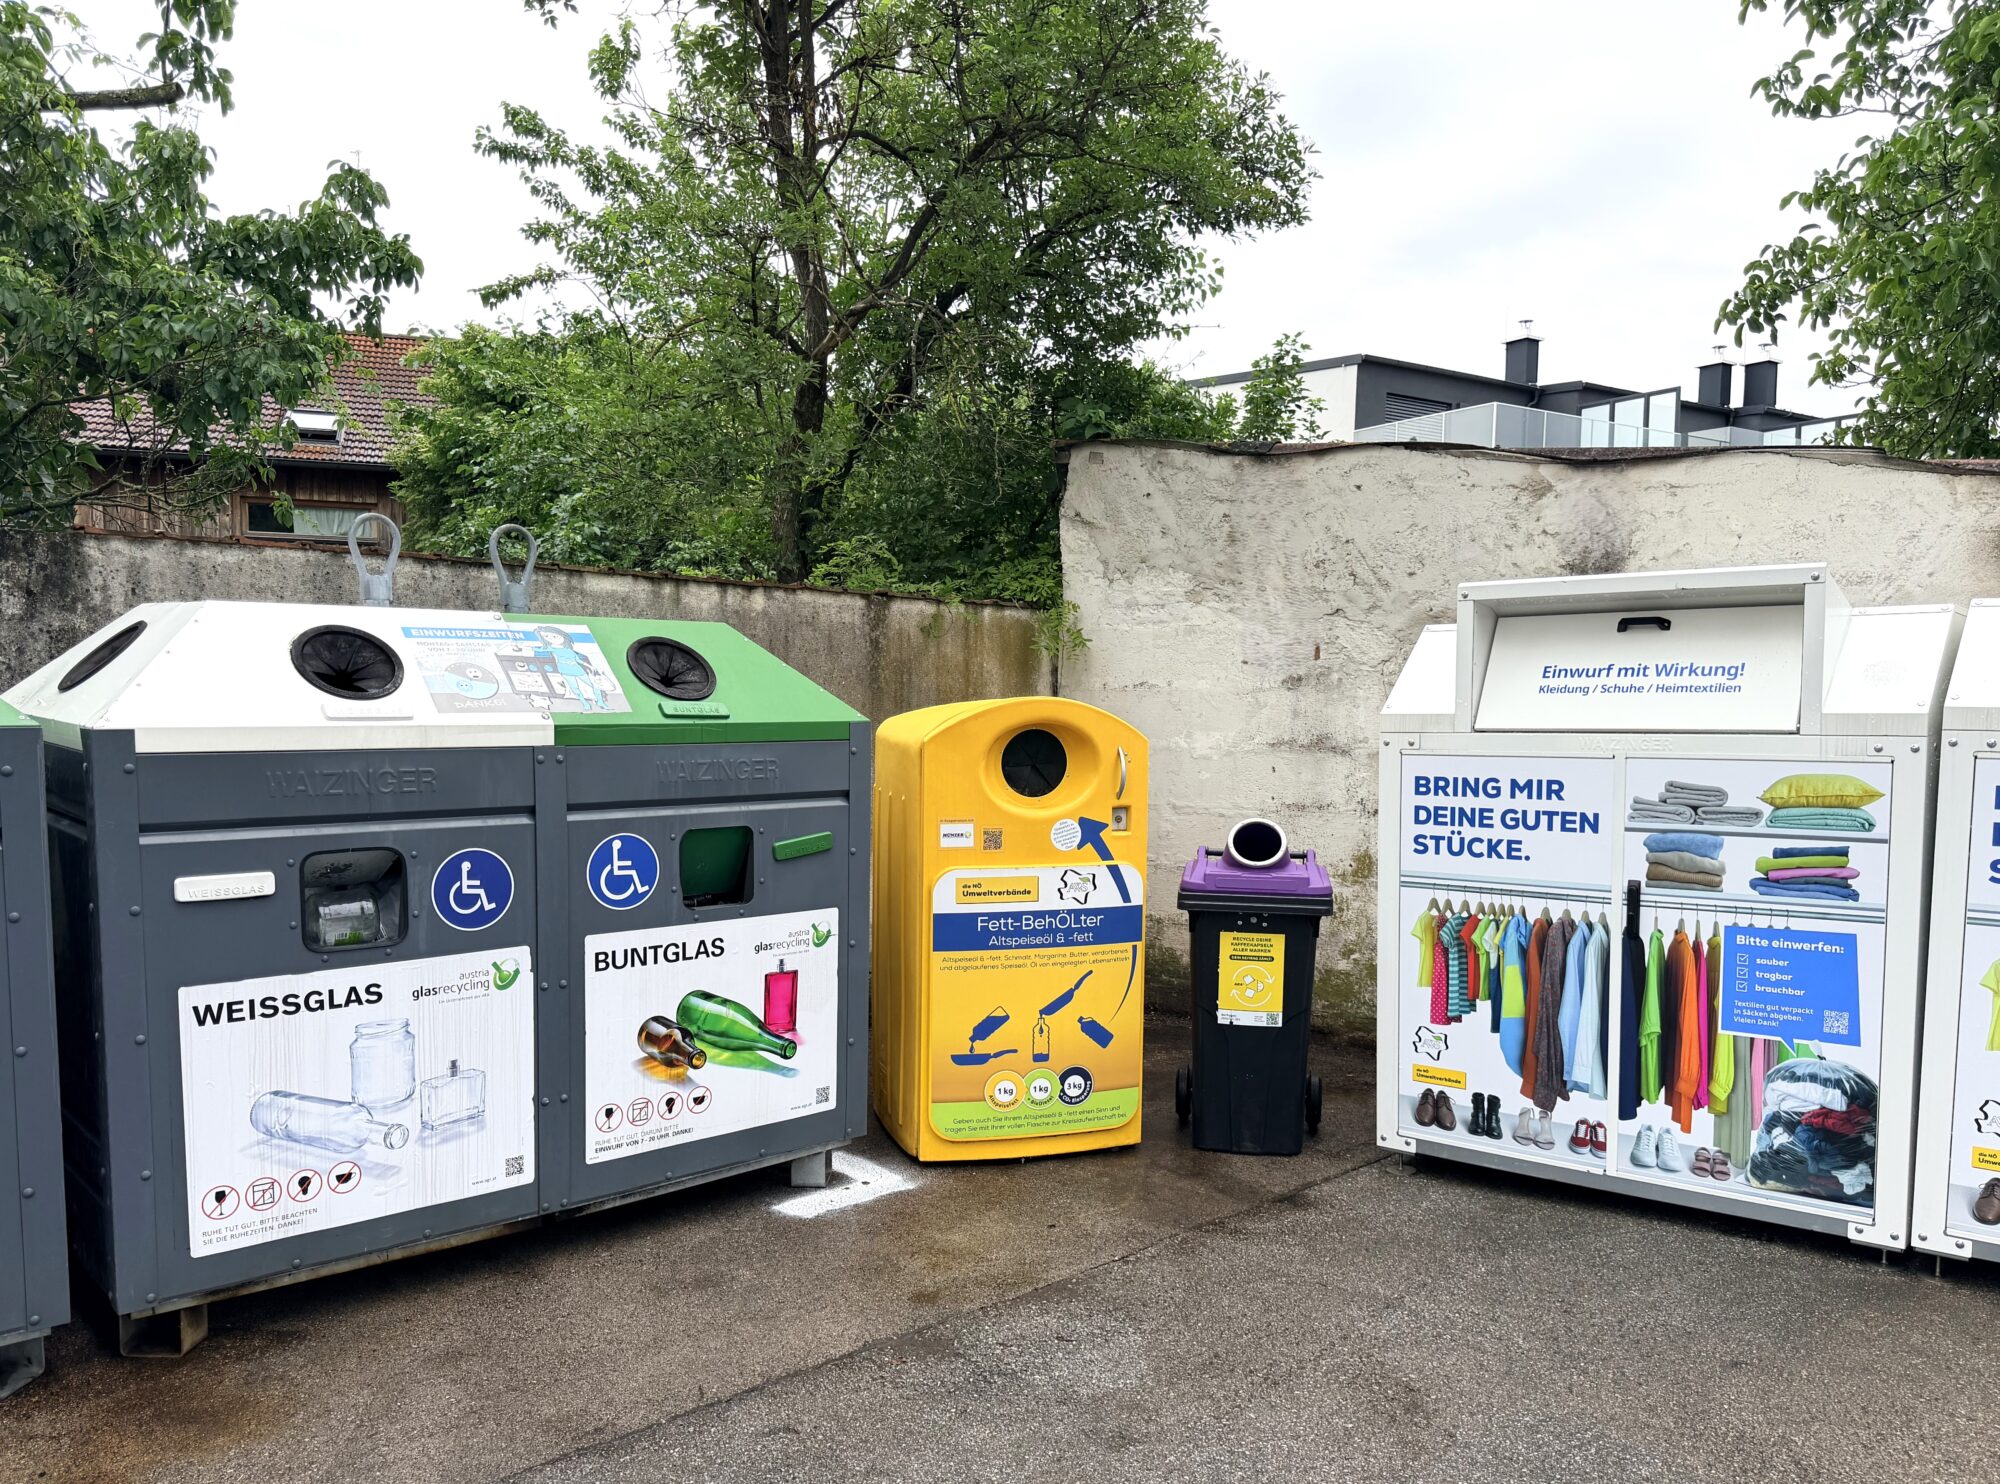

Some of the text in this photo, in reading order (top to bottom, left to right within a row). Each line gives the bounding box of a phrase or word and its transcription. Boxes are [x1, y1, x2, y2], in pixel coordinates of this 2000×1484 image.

[411, 629, 525, 640] EINWURFSZEITEN
[1541, 662, 1746, 680] Einwurf mit Wirkung!
[1538, 683, 1742, 696] Kleidung / Schuhe / Heimtextilien
[656, 758, 780, 784] WAIZINGER
[265, 767, 438, 799] WAIZINGER
[1414, 776, 1565, 801] BRING MIR
[1414, 805, 1600, 834] DEINE GUTEN
[1413, 830, 1531, 861] STÜCKE.
[188, 885, 265, 899] WEISSGLAS
[962, 888, 1032, 898] Umweltverbände
[977, 910, 1104, 931] Fett-BehÖLter
[788, 929, 810, 938] austria
[988, 932, 1093, 947] Altspeiseöl & -fett
[754, 937, 810, 954] glasrecycling
[1736, 935, 1845, 954] Bitte einwerfen:
[594, 937, 725, 972] BUNTGLAS
[1756, 957, 1790, 967] sauber
[459, 969, 490, 980] austria
[954, 964, 999, 972] abgelaufenes
[1755, 970, 1793, 981] tragbar
[412, 979, 490, 1001] glasrecycling
[1755, 984, 1806, 996] brauchbar
[192, 983, 383, 1027] WEISSGLAS
[1734, 1000, 1814, 1015] Textilien gut verpackt
[1733, 1016, 1779, 1027] Vielen Dank!
[1742, 1007, 1768, 1018] Säcken
[1769, 1012, 1804, 1022] abgeben.
[1416, 1073, 1462, 1084] Umweltverbände
[1003, 1087, 1014, 1096] kg
[1038, 1085, 1049, 1093] kg
[1072, 1082, 1082, 1091] kg
[594, 1143, 624, 1154] EINWURF
[625, 1139, 640, 1147] VON
[672, 1127, 694, 1137] DANKE!
[595, 1138, 613, 1147] RUHE
[613, 1135, 625, 1143] TUT
[641, 1128, 662, 1138] DARUM
[663, 1124, 679, 1133] BITTE
[202, 1228, 222, 1238] RUHE
[225, 1225, 239, 1233] TUT
[259, 1216, 279, 1226] BITTE
[281, 1207, 318, 1221] BEACHTEN
[202, 1237, 214, 1246] SIE
[216, 1234, 228, 1243] DIE
[277, 1218, 304, 1229] DANKE!
